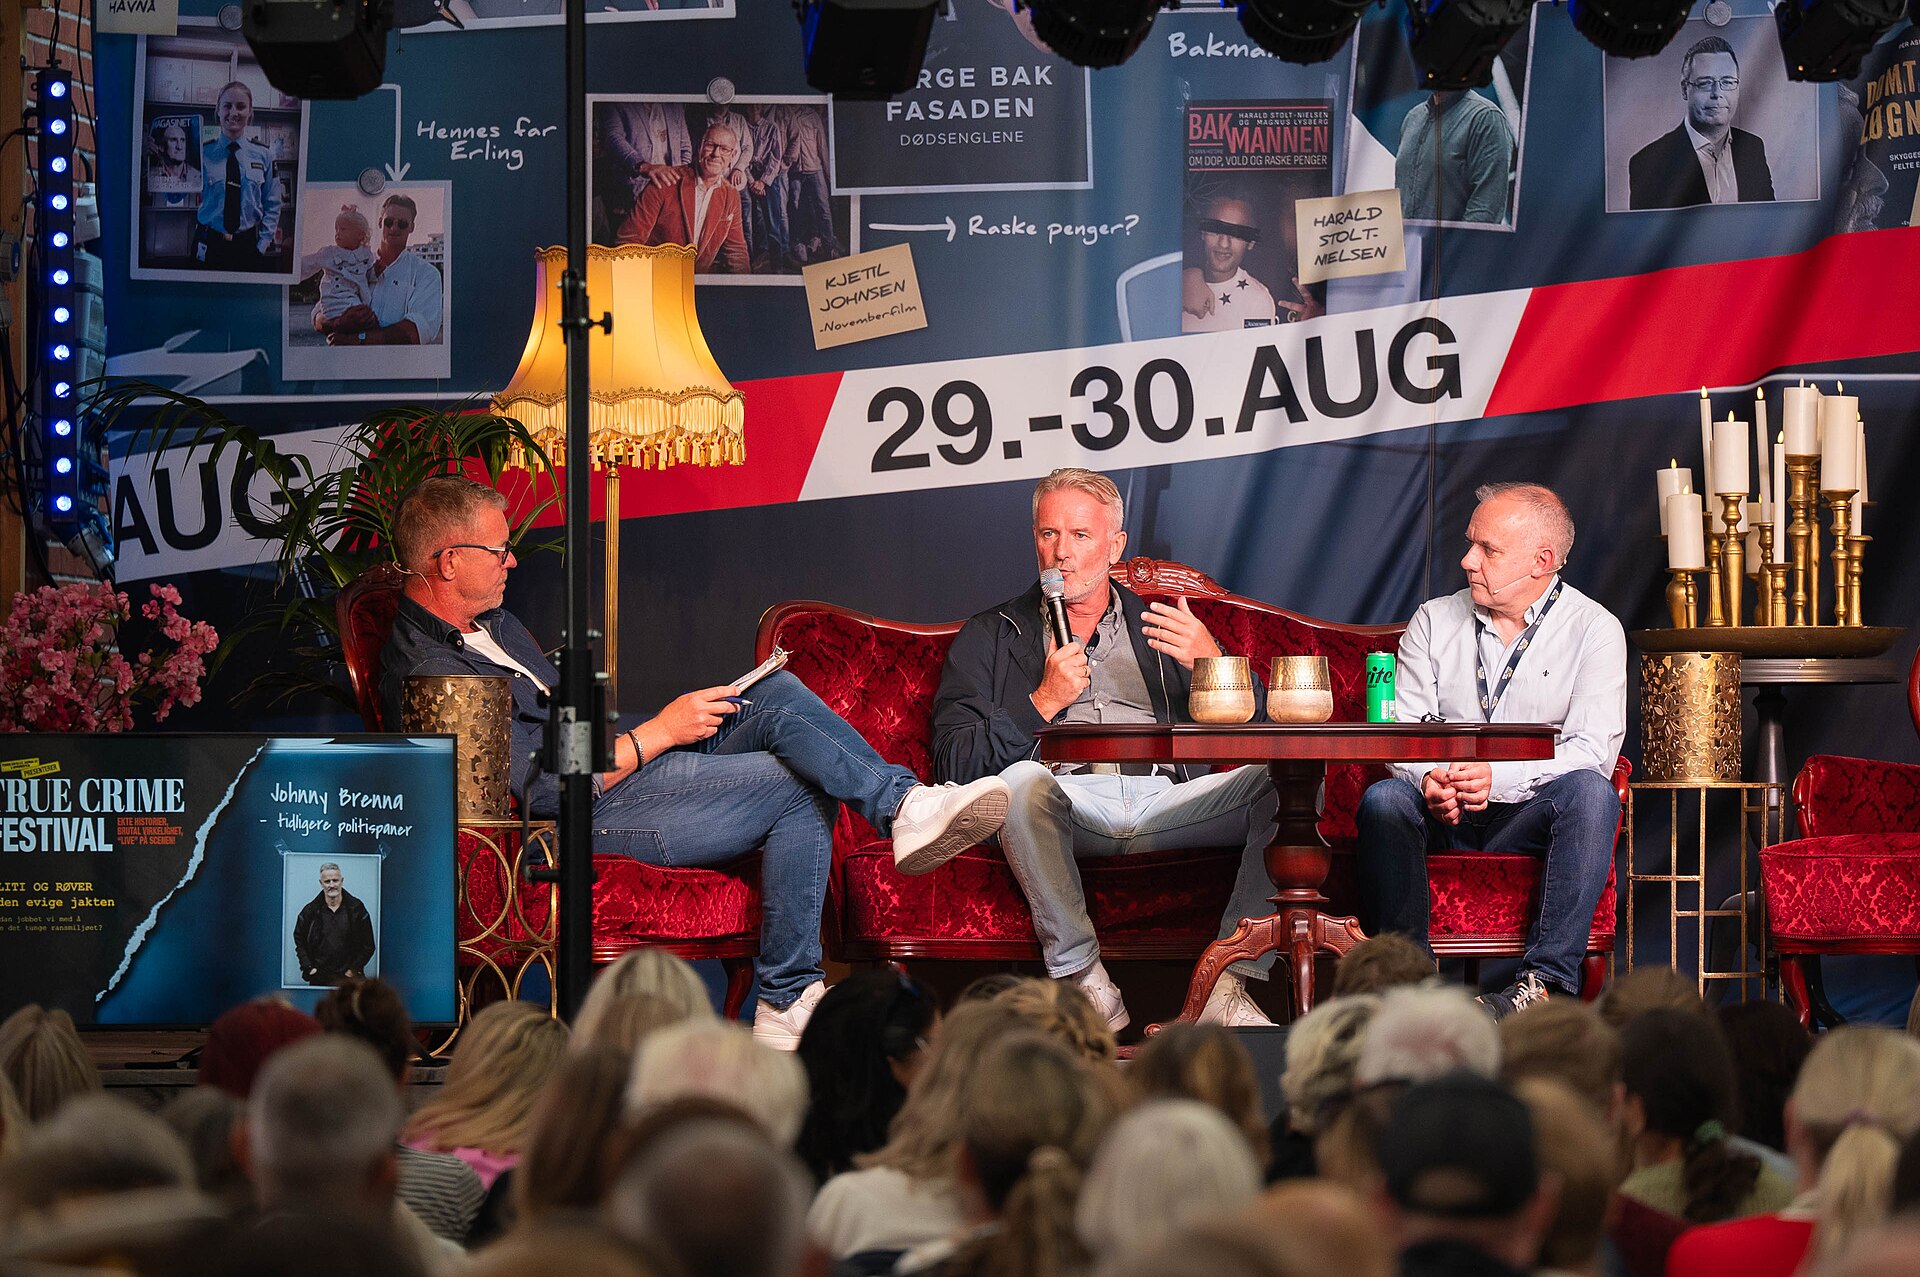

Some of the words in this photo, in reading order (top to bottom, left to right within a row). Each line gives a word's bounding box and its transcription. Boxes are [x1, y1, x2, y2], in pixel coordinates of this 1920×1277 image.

[1167, 31, 1281, 60] Bakma
[915, 67, 976, 89] RGE
[991, 65, 1053, 87] BAK
[886, 97, 1034, 122] FASADEN
[416, 120, 501, 140] Hennes
[513, 116, 558, 138] far
[900, 130, 1025, 146] DØDSENGLENE
[1188, 113, 1234, 153] BAK
[1230, 126, 1329, 153] MANNEN
[450, 139, 524, 171] Erling
[1188, 156, 1203, 167] OM
[1204, 156, 1224, 167] DOP,
[1226, 156, 1248, 166] VOLD
[1249, 155, 1263, 166] OG
[1264, 155, 1291, 165] RASKE
[1293, 155, 1328, 165] PENGER
[1893, 162, 1915, 171] FELTE
[1313, 207, 1383, 227] HARALD
[968, 215, 1037, 236] Raske
[1047, 214, 1140, 246] penger?
[825, 264, 890, 290] KJETIL
[820, 279, 906, 312] JOHNSEN
[113, 452, 306, 562] AUG
[78, 777, 185, 813] CRIME
[270, 782, 328, 814] Johnny
[338, 787, 404, 811] Brenna
[117, 817, 133, 826] EKTE
[117, 826, 141, 835] BRUTAL
[277, 812, 332, 837] tidligere
[337, 817, 413, 840] politispaner
[33, 882, 49, 892] OG
[55, 882, 94, 892] RØVER
[26, 897, 63, 910] evige
[71, 897, 115, 909] jakten
